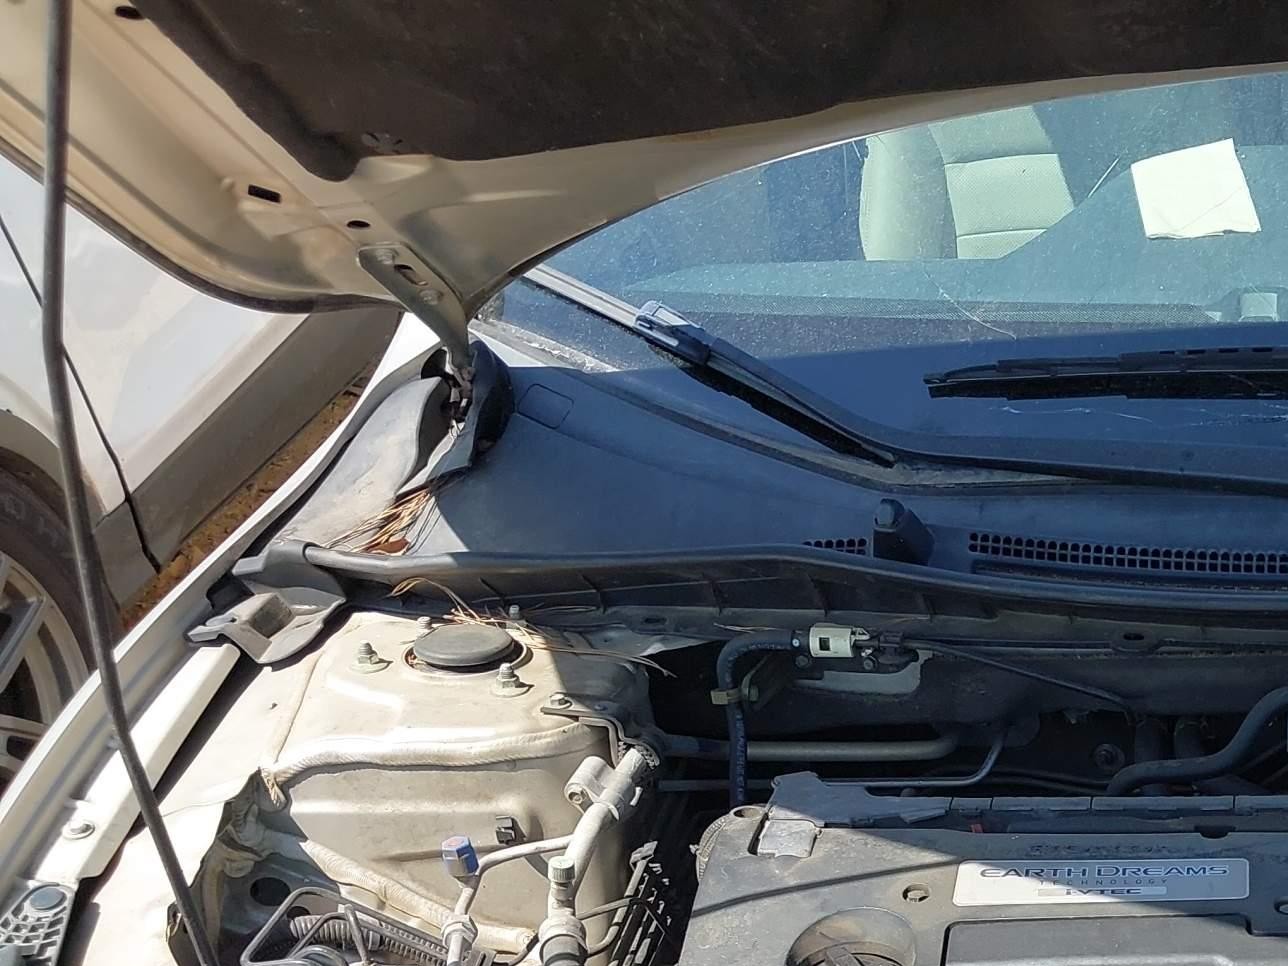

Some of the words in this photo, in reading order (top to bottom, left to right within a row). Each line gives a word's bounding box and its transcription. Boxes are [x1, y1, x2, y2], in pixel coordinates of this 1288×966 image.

[980, 866, 1088, 879] EARTH
[1096, 864, 1229, 877] DREAMS
[1040, 878, 1169, 886] TECHNOLOGY
